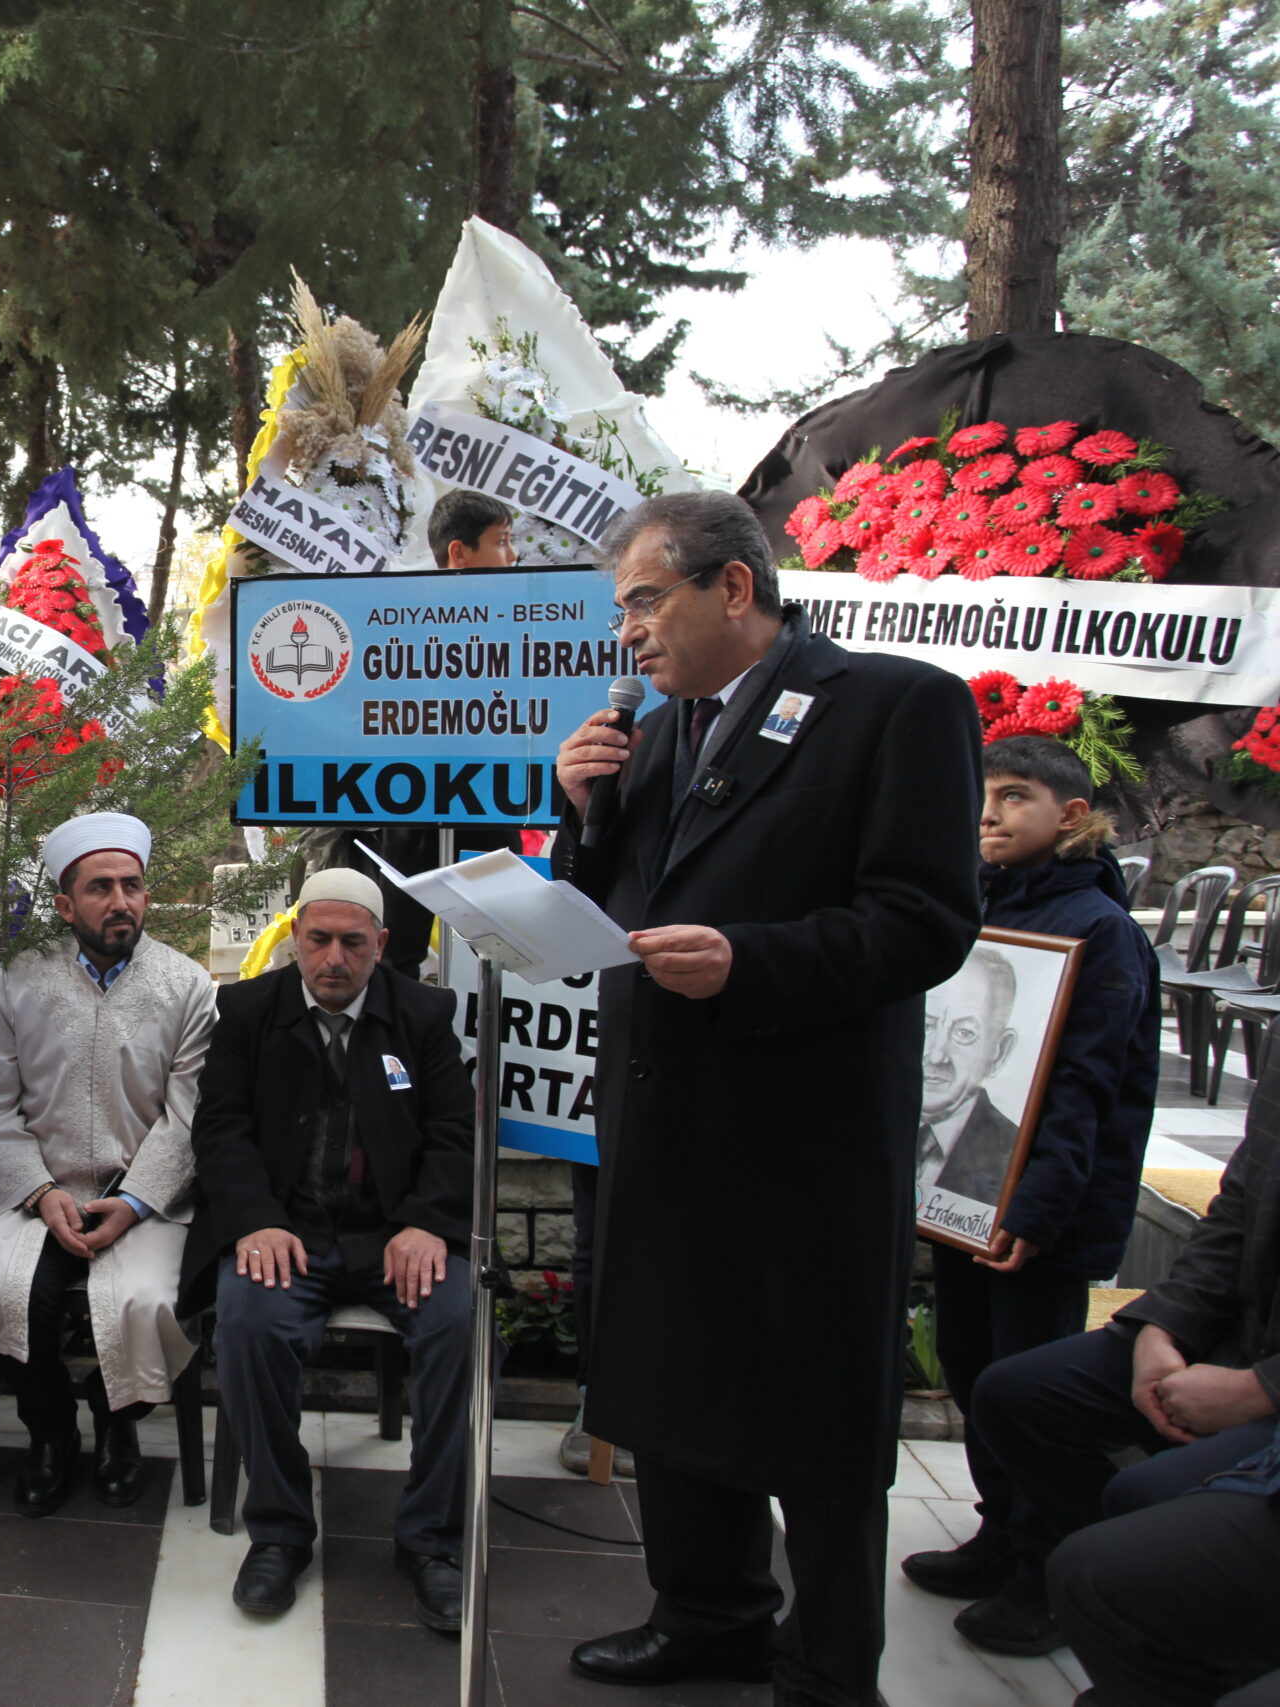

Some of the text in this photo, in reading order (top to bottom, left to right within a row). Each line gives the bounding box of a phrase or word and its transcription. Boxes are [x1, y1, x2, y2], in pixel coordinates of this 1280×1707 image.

[405, 416, 510, 490] BESNİ
[234, 500, 282, 539] BESNİ
[276, 527, 327, 566] ESNAF
[251, 475, 387, 572] HAYATİ
[260, 608, 281, 629] MİLLİ
[281, 602, 312, 614] EĞİTİM
[314, 606, 349, 644] BAKANLIĞI
[367, 606, 489, 626] ADIYAMAN
[513, 600, 585, 623] BESNİ
[864, 597, 1048, 651] ERDEMOĞLU
[1051, 600, 1243, 666] İLKOKULU
[42, 645, 97, 687] AR
[362, 635, 510, 680] GÜLÜSÜM
[362, 690, 549, 736] ERDEMOĞLU
[254, 749, 560, 816] İLKOKU
